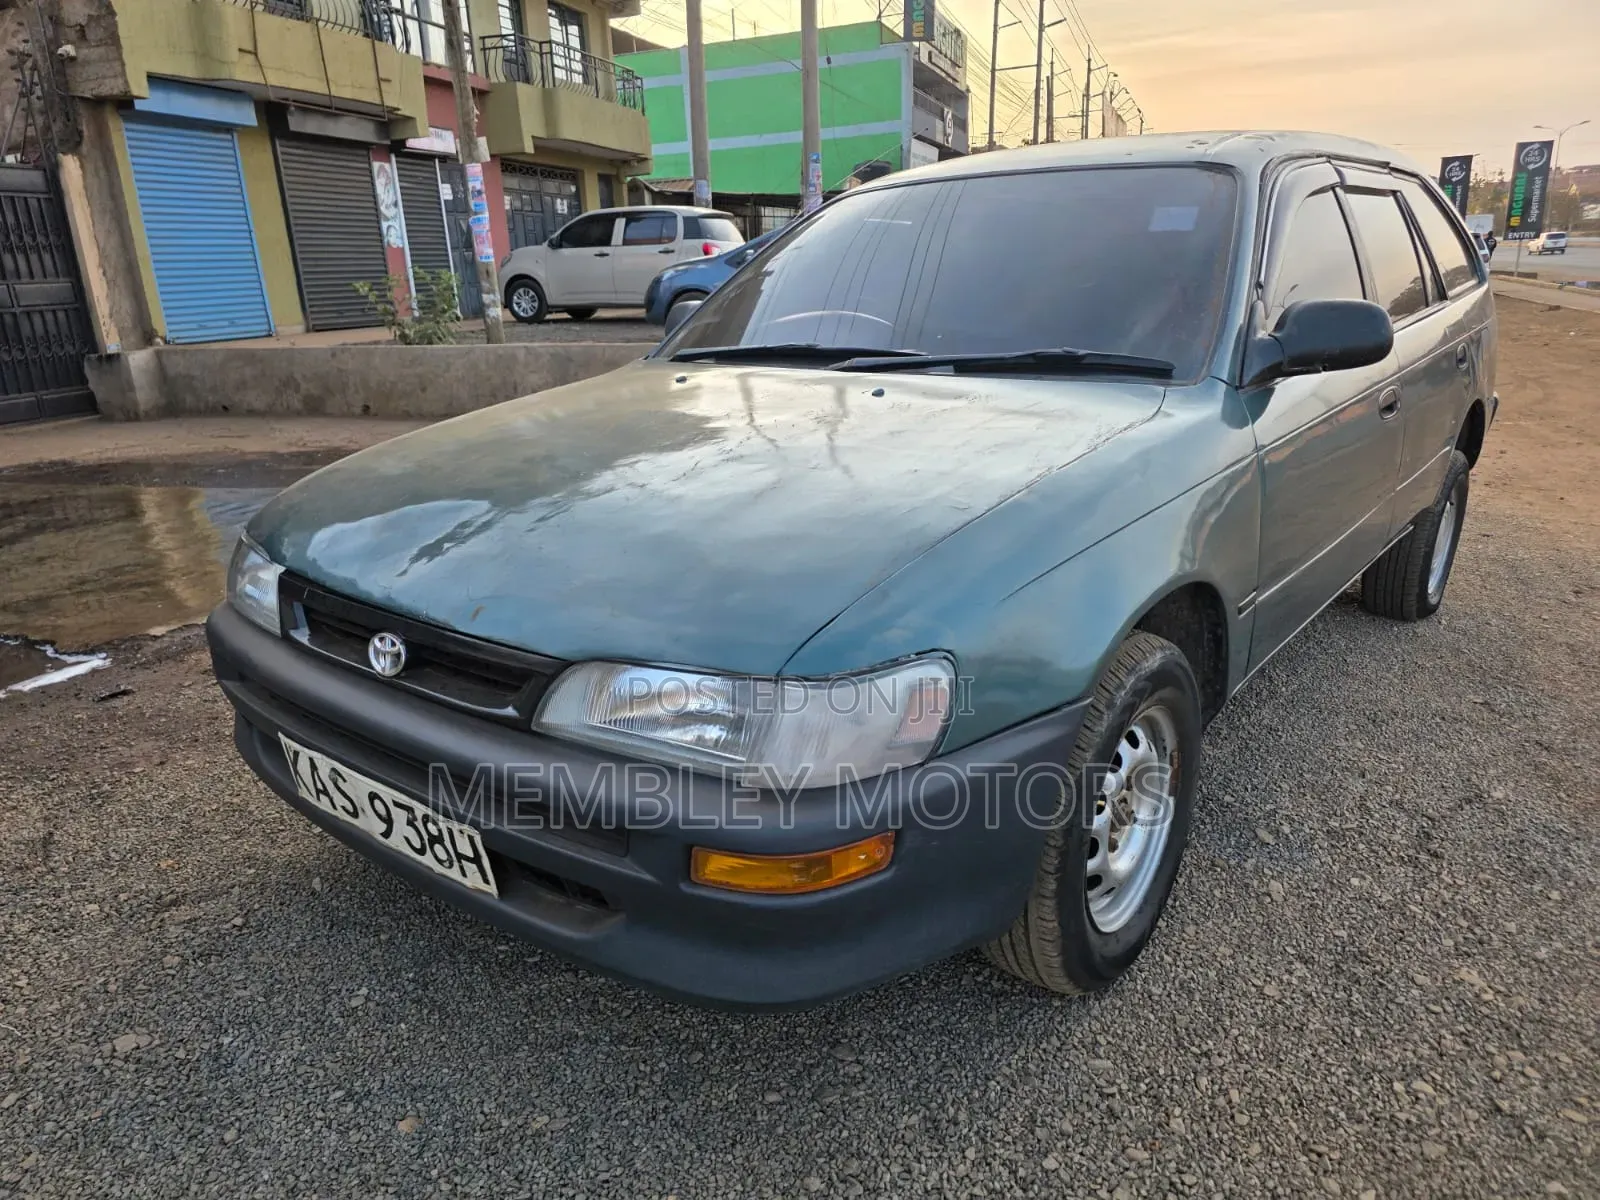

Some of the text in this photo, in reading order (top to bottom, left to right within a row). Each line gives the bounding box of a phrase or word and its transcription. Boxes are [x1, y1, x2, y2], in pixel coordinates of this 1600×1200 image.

[1528, 175, 1544, 223] Supermarket
[1508, 231, 1535, 239] ENTRY
[285, 743, 491, 885] KAS 938H
